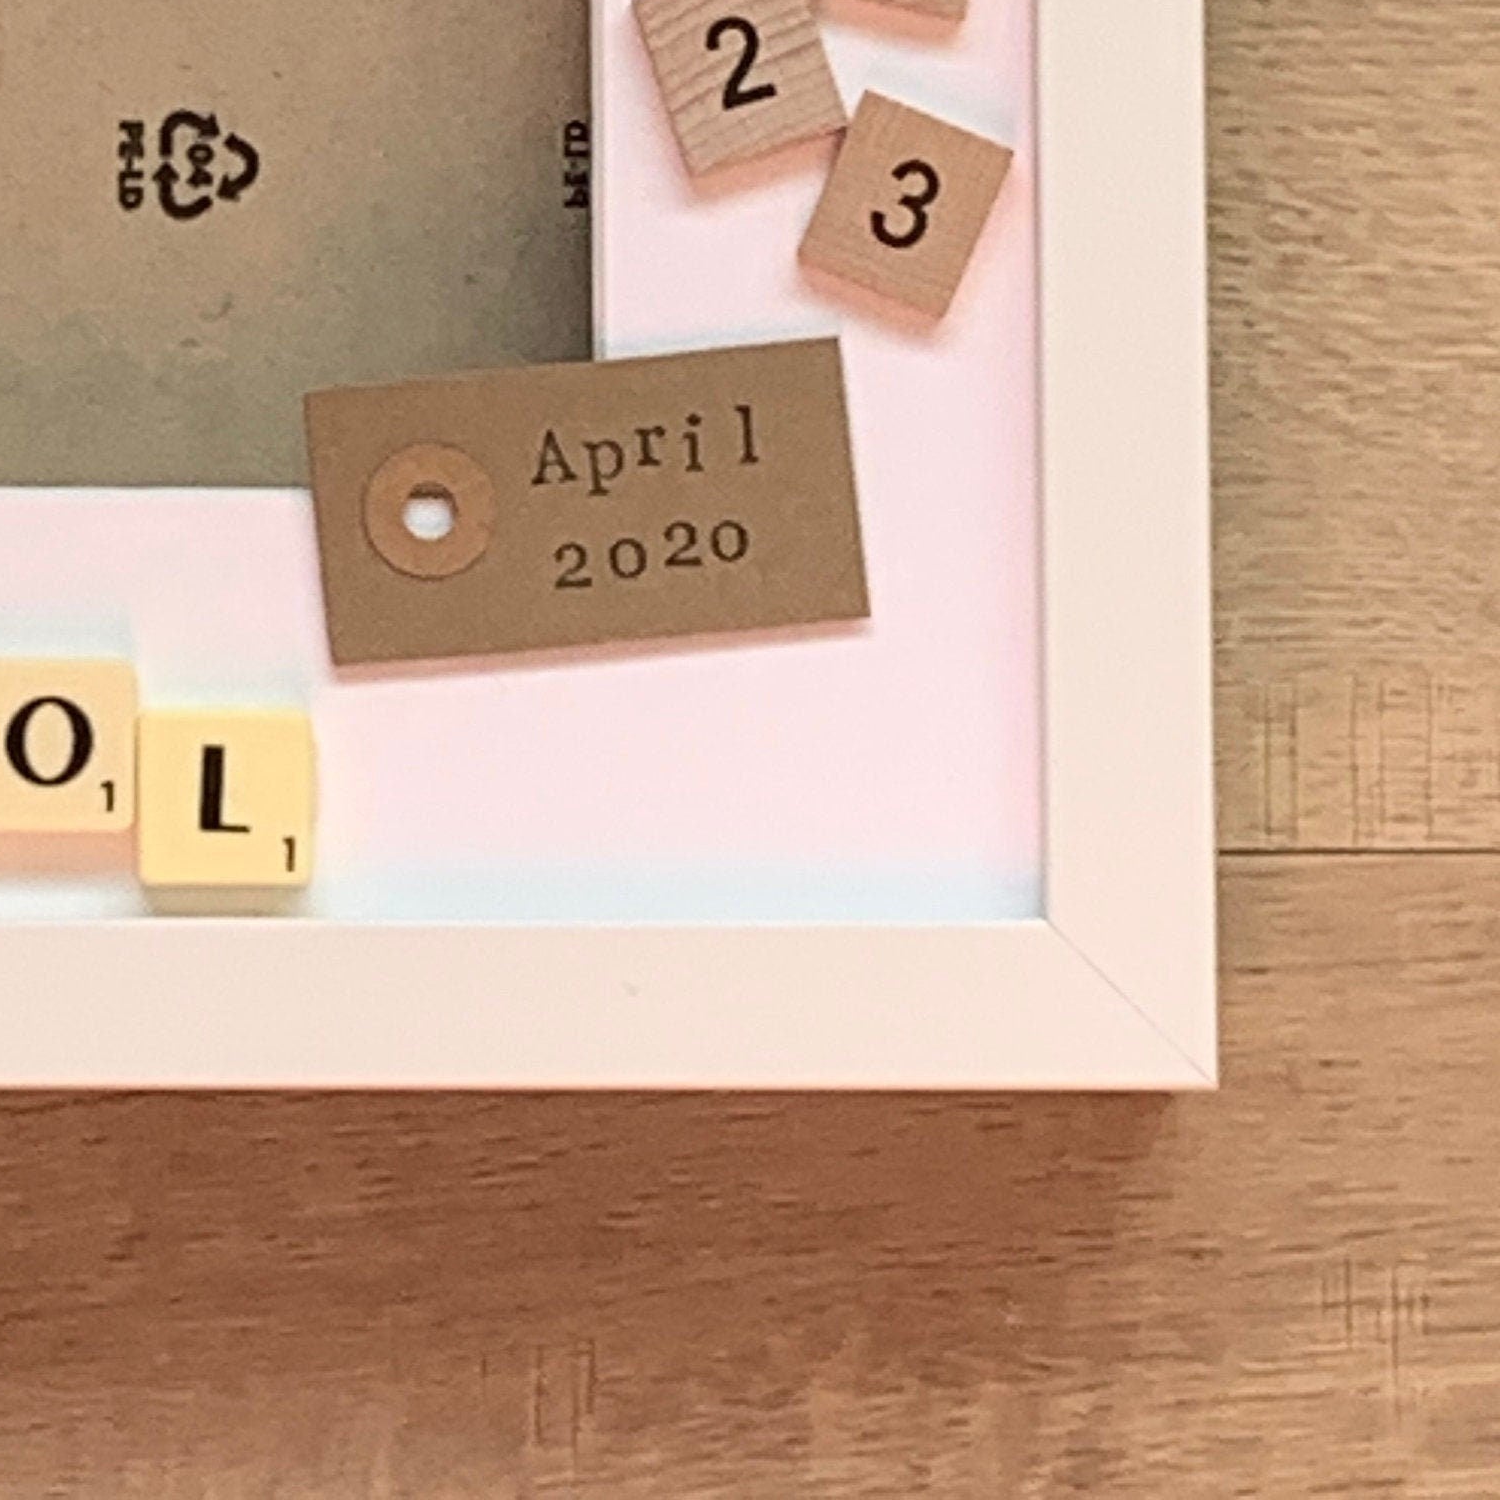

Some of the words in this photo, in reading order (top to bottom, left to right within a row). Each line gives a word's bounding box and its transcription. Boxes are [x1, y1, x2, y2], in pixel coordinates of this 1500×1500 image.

[705, 16, 778, 111] 2
[870, 158, 940, 249] 3
[530, 403, 760, 497] April
[553, 518, 750, 590] 2020
[100, 779, 115, 814] 1
[282, 835, 297, 874] 1
